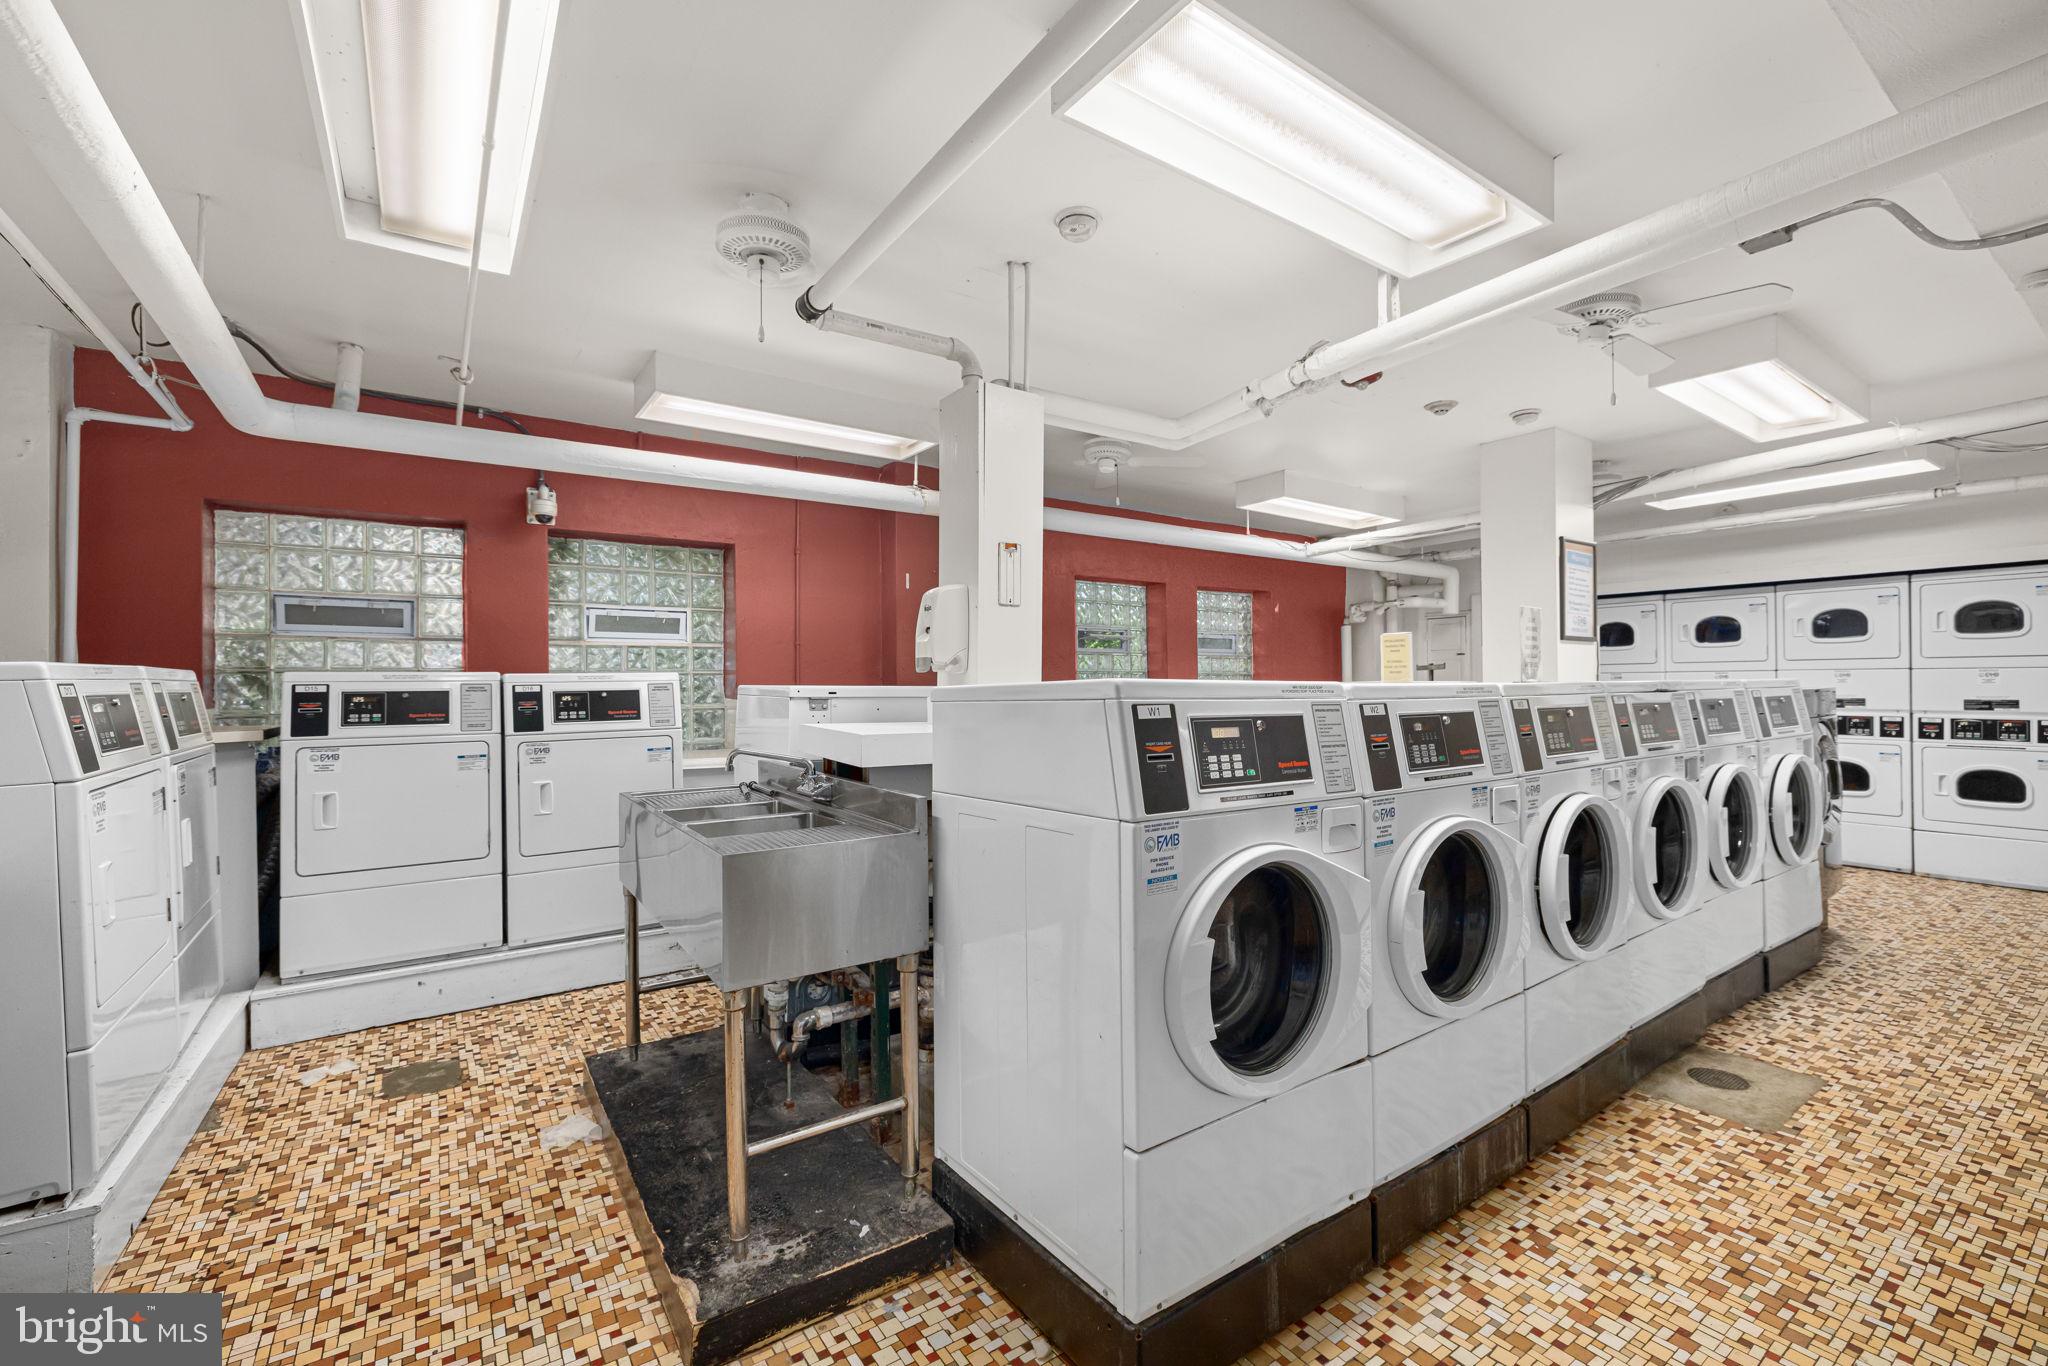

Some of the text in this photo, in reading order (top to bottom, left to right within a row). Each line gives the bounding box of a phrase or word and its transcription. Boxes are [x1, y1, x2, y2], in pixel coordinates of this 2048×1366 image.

[1147, 707, 1161, 717] W1
[1369, 705, 1379, 714] W2
[1380, 807, 1396, 822] FMB
[1156, 833, 1180, 852] FMB
